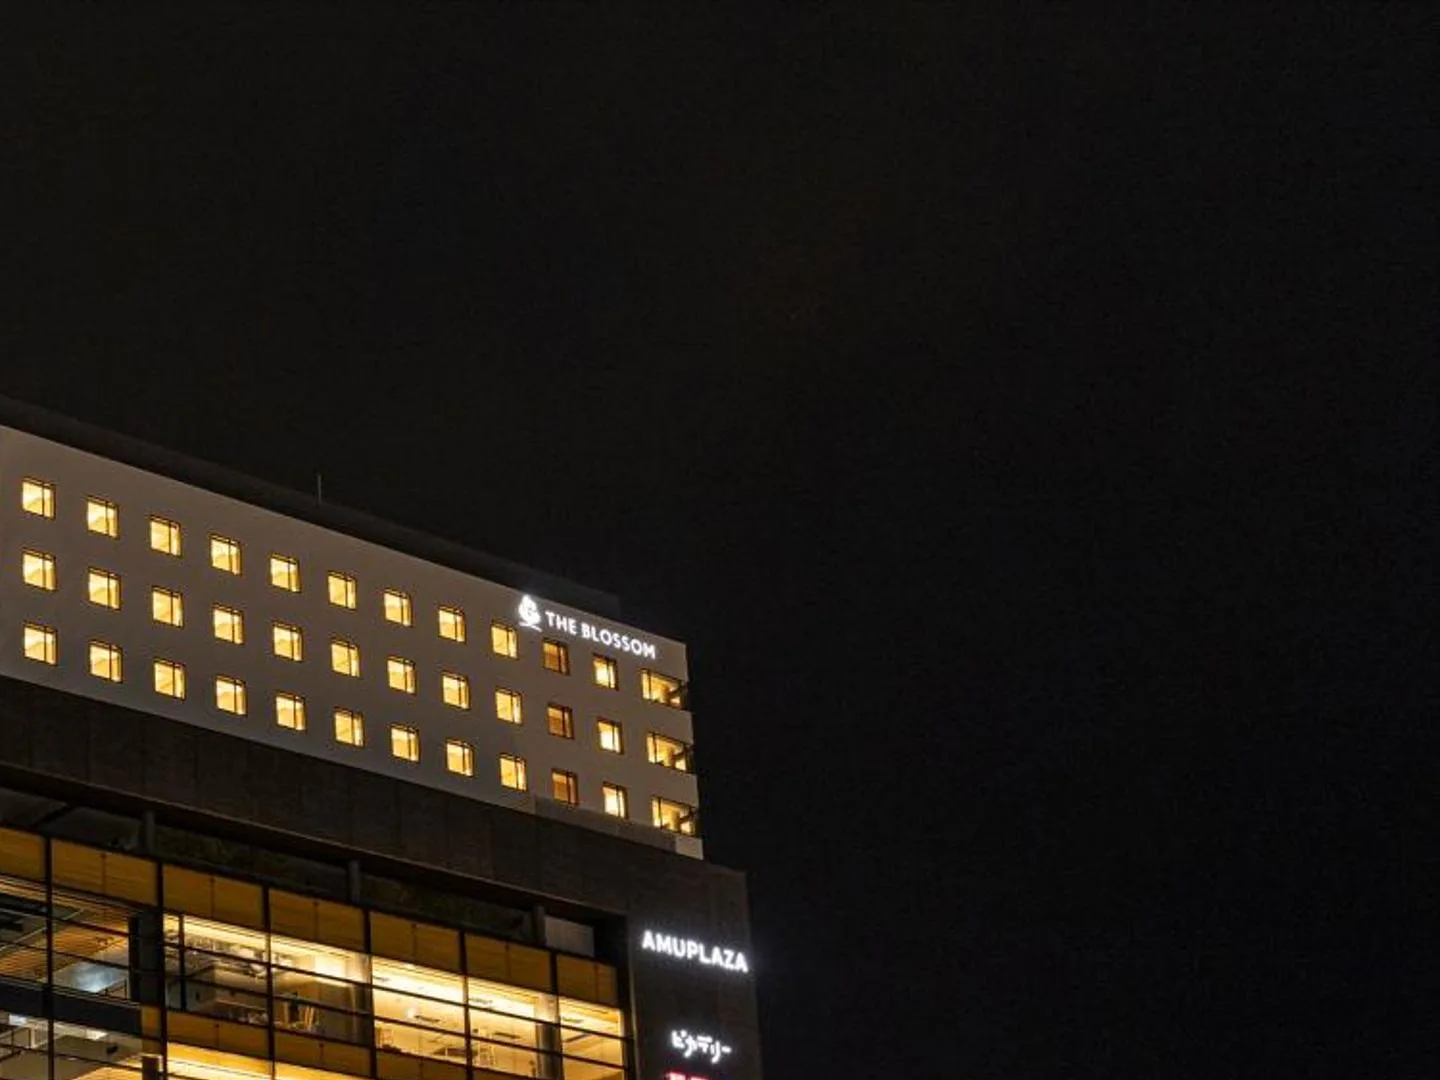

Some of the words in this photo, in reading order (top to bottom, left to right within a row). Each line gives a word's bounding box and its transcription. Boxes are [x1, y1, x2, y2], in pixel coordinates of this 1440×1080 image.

[545, 611, 577, 636] THE
[580, 622, 656, 660] BLOSSOM
[641, 930, 749, 973] AMUPLAZA
